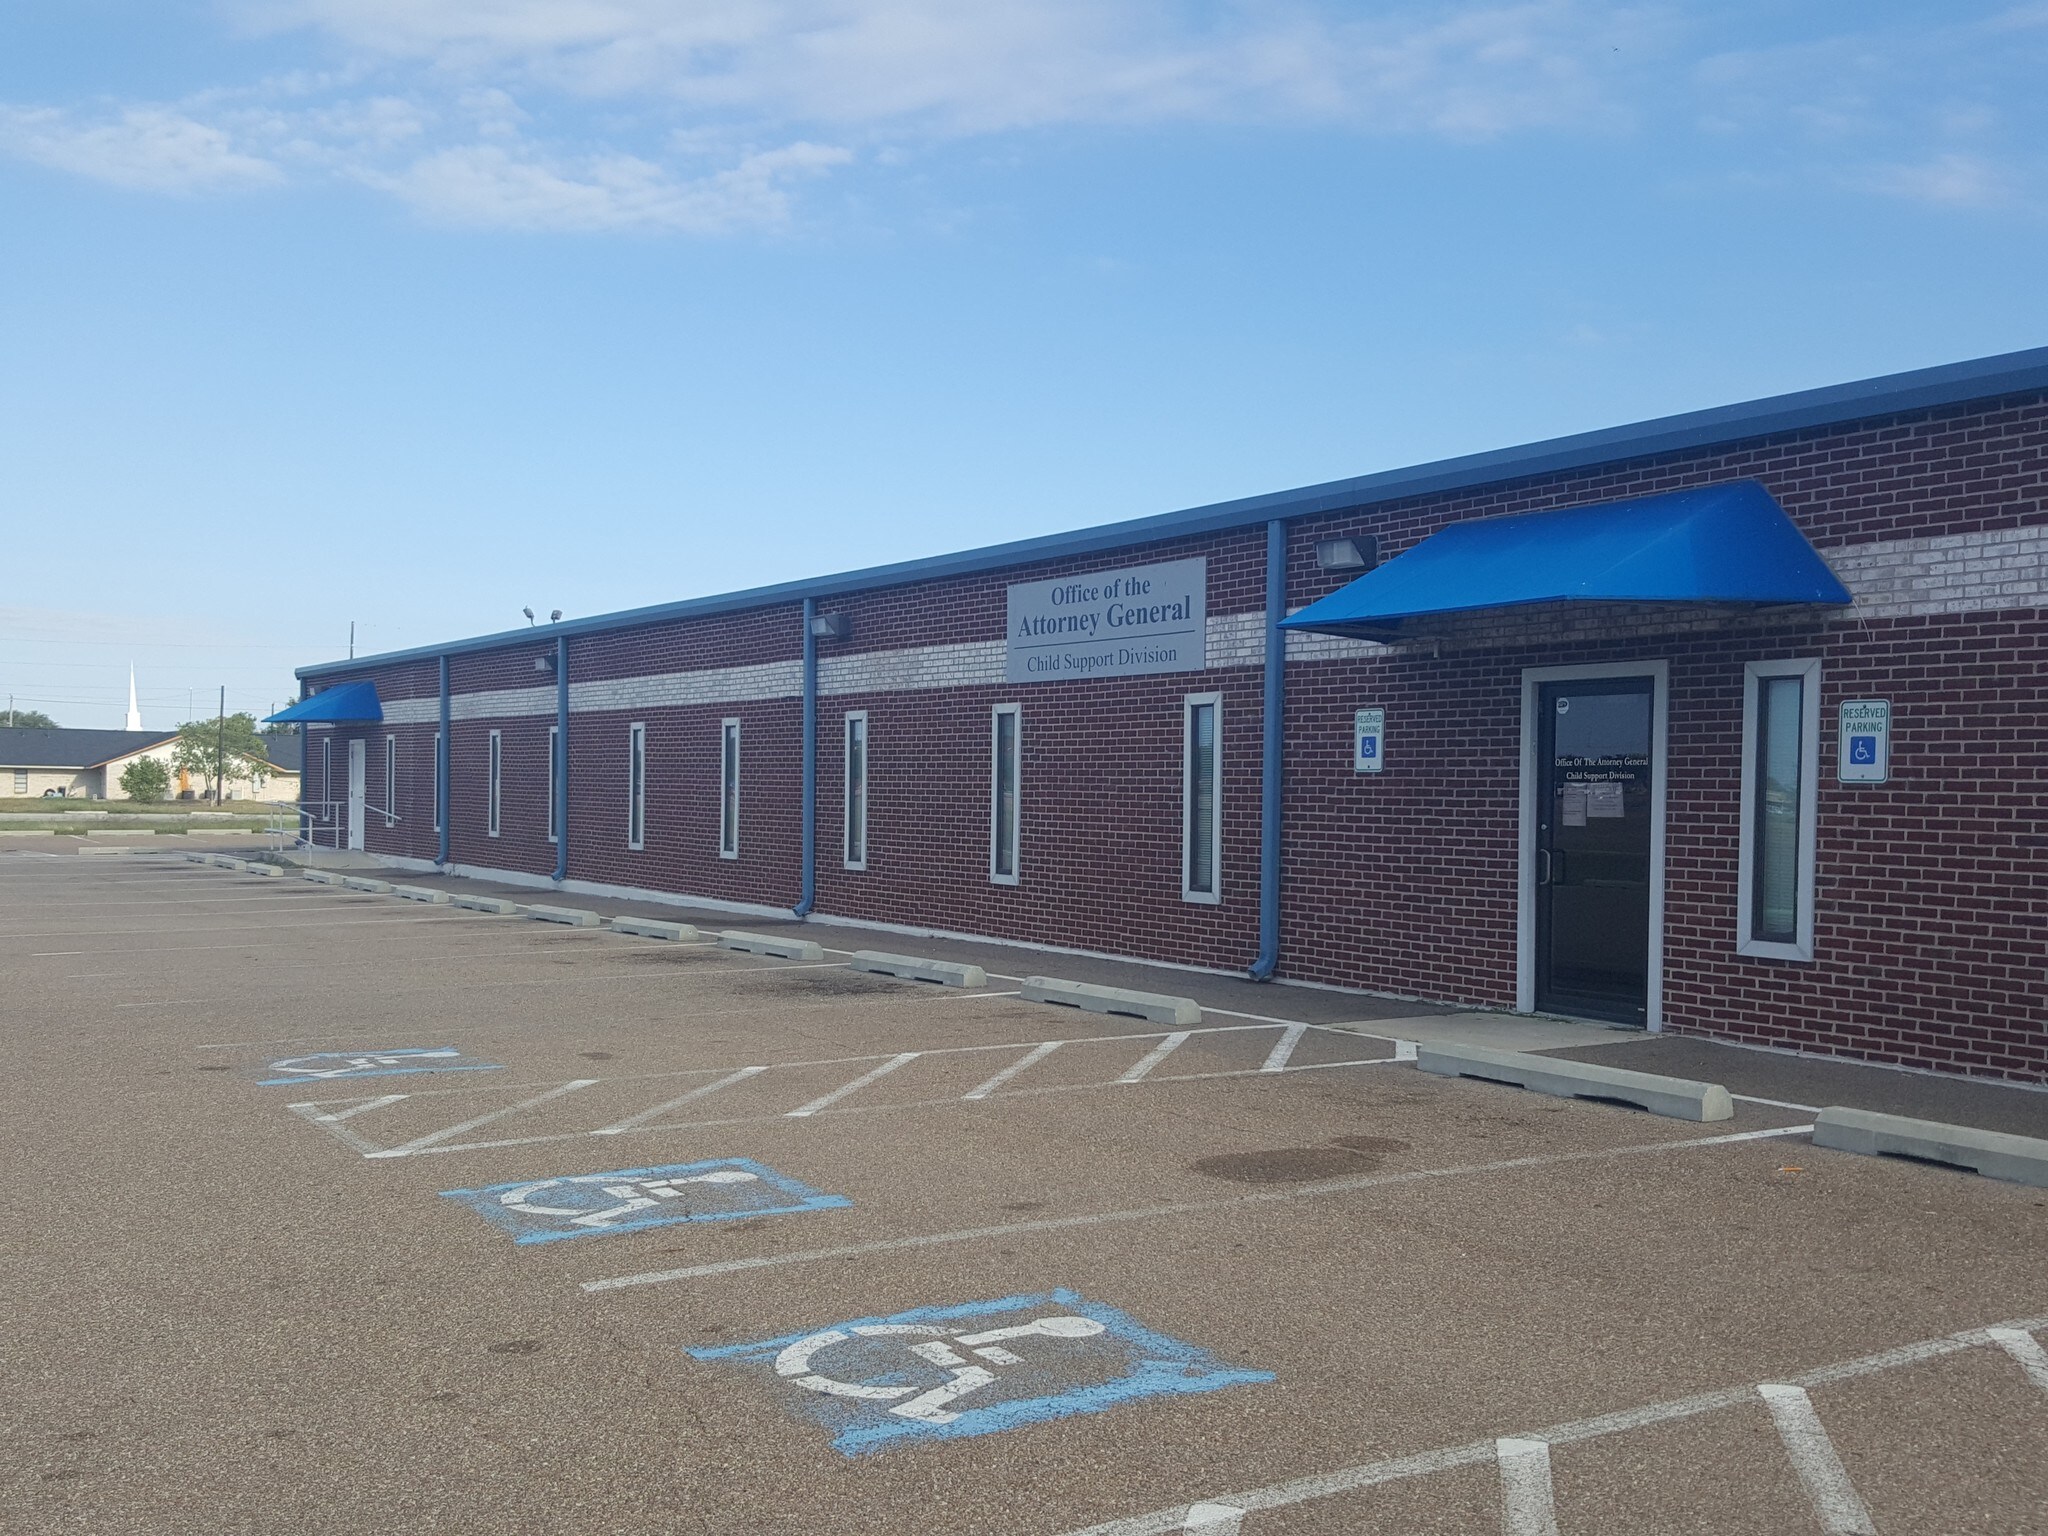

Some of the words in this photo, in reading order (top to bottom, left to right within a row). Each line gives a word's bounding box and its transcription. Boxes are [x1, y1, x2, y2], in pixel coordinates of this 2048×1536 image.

[1051, 584, 1099, 606] Office
[1104, 578, 1121, 600] of
[1125, 577, 1150, 597] the
[1018, 612, 1100, 637] Attorney
[1106, 595, 1191, 628] General
[1027, 654, 1060, 672] Child
[1064, 652, 1114, 672] Support
[1118, 645, 1177, 666] Division
[1357, 715, 1382, 723] RESERVED
[1843, 708, 1886, 719] RESERVED
[1358, 725, 1380, 733] PARKING
[1845, 722, 1882, 732] PARKING
[1555, 758, 1573, 767] Office
[1574, 758, 1582, 767] Of
[1584, 758, 1597, 767] The
[1598, 758, 1623, 768] Attorney
[1624, 757, 1649, 766] General
[1566, 771, 1583, 780] Child
[1583, 771, 1608, 782] Support
[1609, 771, 1635, 780] Division
